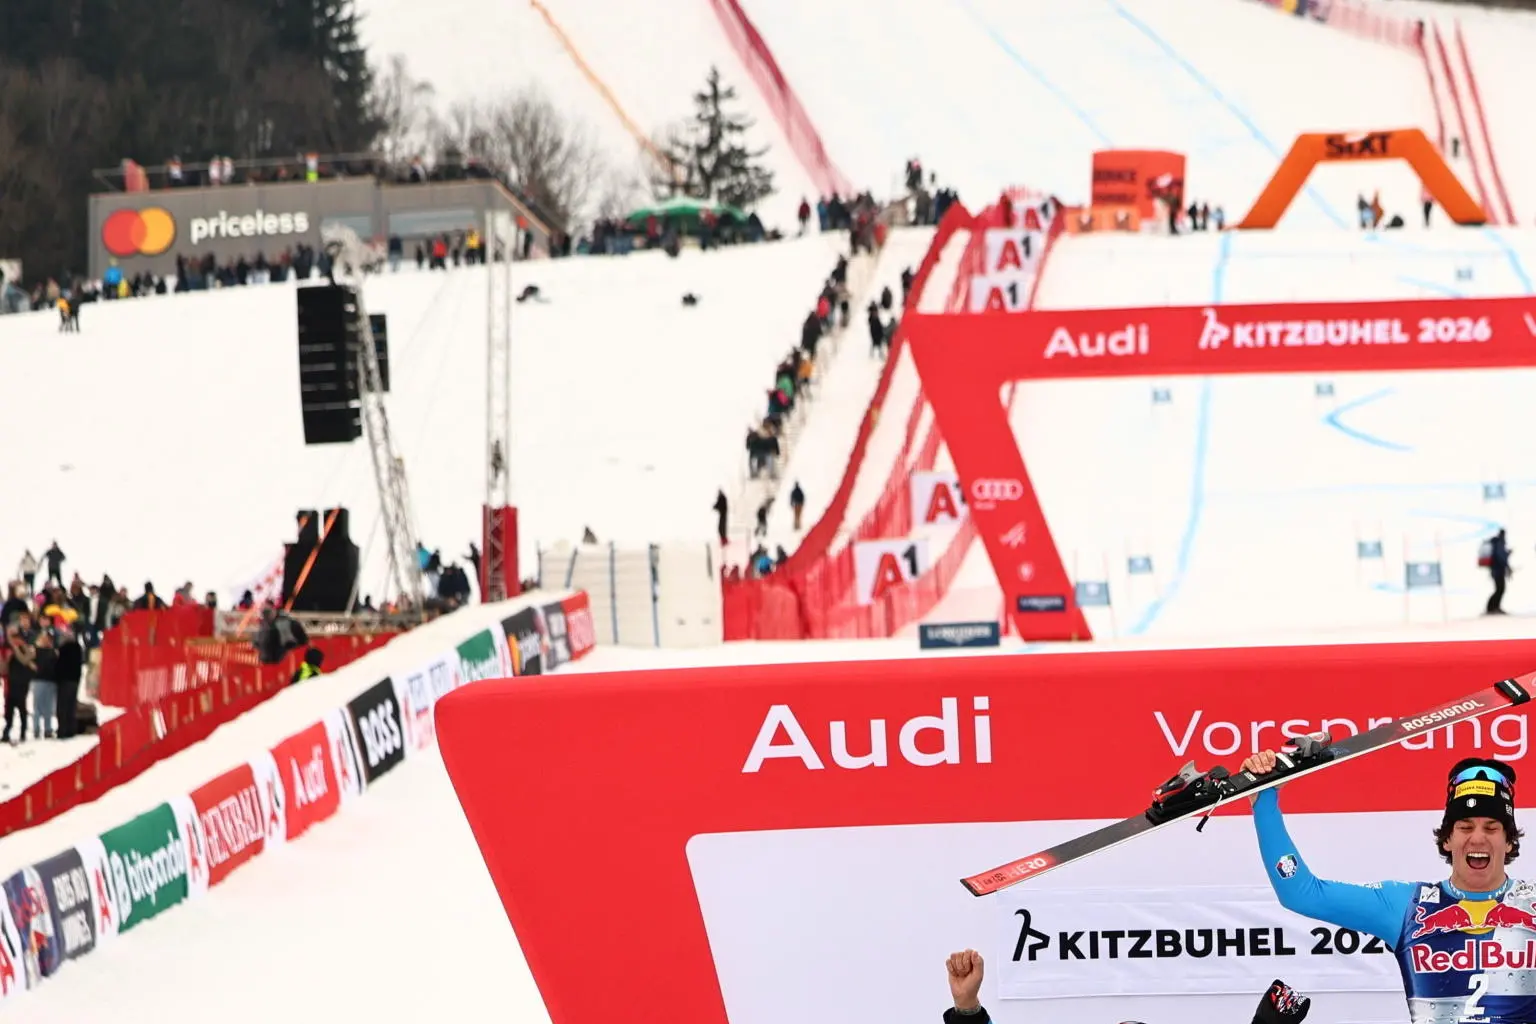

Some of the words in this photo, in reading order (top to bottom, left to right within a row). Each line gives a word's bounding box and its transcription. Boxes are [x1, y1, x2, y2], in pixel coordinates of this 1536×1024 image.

[191, 208, 309, 244] priceless
[997, 235, 1032, 271] A1
[1043, 323, 1150, 359] Audi
[1417, 316, 1492, 343] 2026
[871, 543, 918, 600] A1
[359, 698, 401, 768] BOSS
[742, 695, 993, 774] Audi
[1401, 698, 1486, 733] ROSSIGNOL
[289, 744, 328, 809] Audi
[200, 785, 265, 868] GENERALI
[1411, 940, 1477, 973] Red
[1462, 973, 1491, 1016] 2
